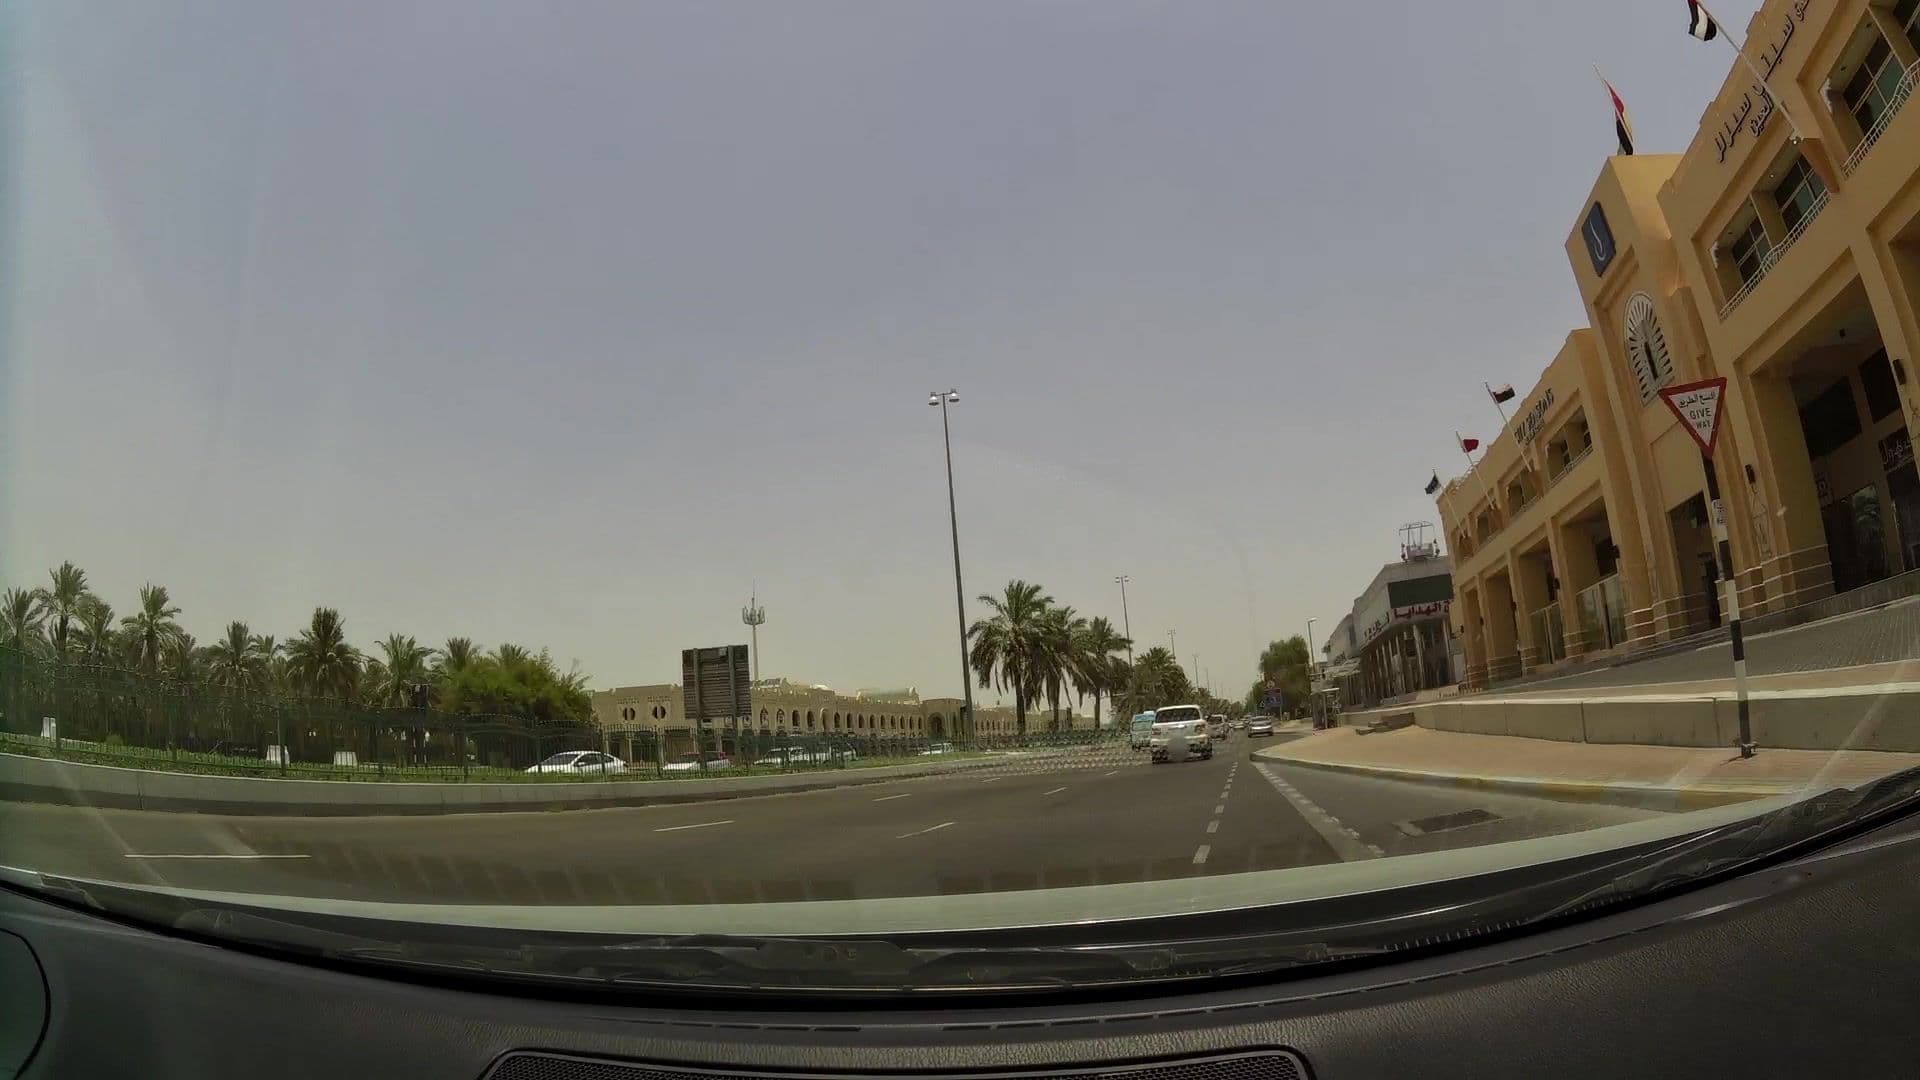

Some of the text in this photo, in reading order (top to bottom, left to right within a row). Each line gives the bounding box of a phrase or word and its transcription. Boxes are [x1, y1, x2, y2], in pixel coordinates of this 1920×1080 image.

[1690, 408, 1712, 420] GIVE
[1696, 419, 1711, 429] WAY
[1394, 602, 1441, 619] الهدايا
